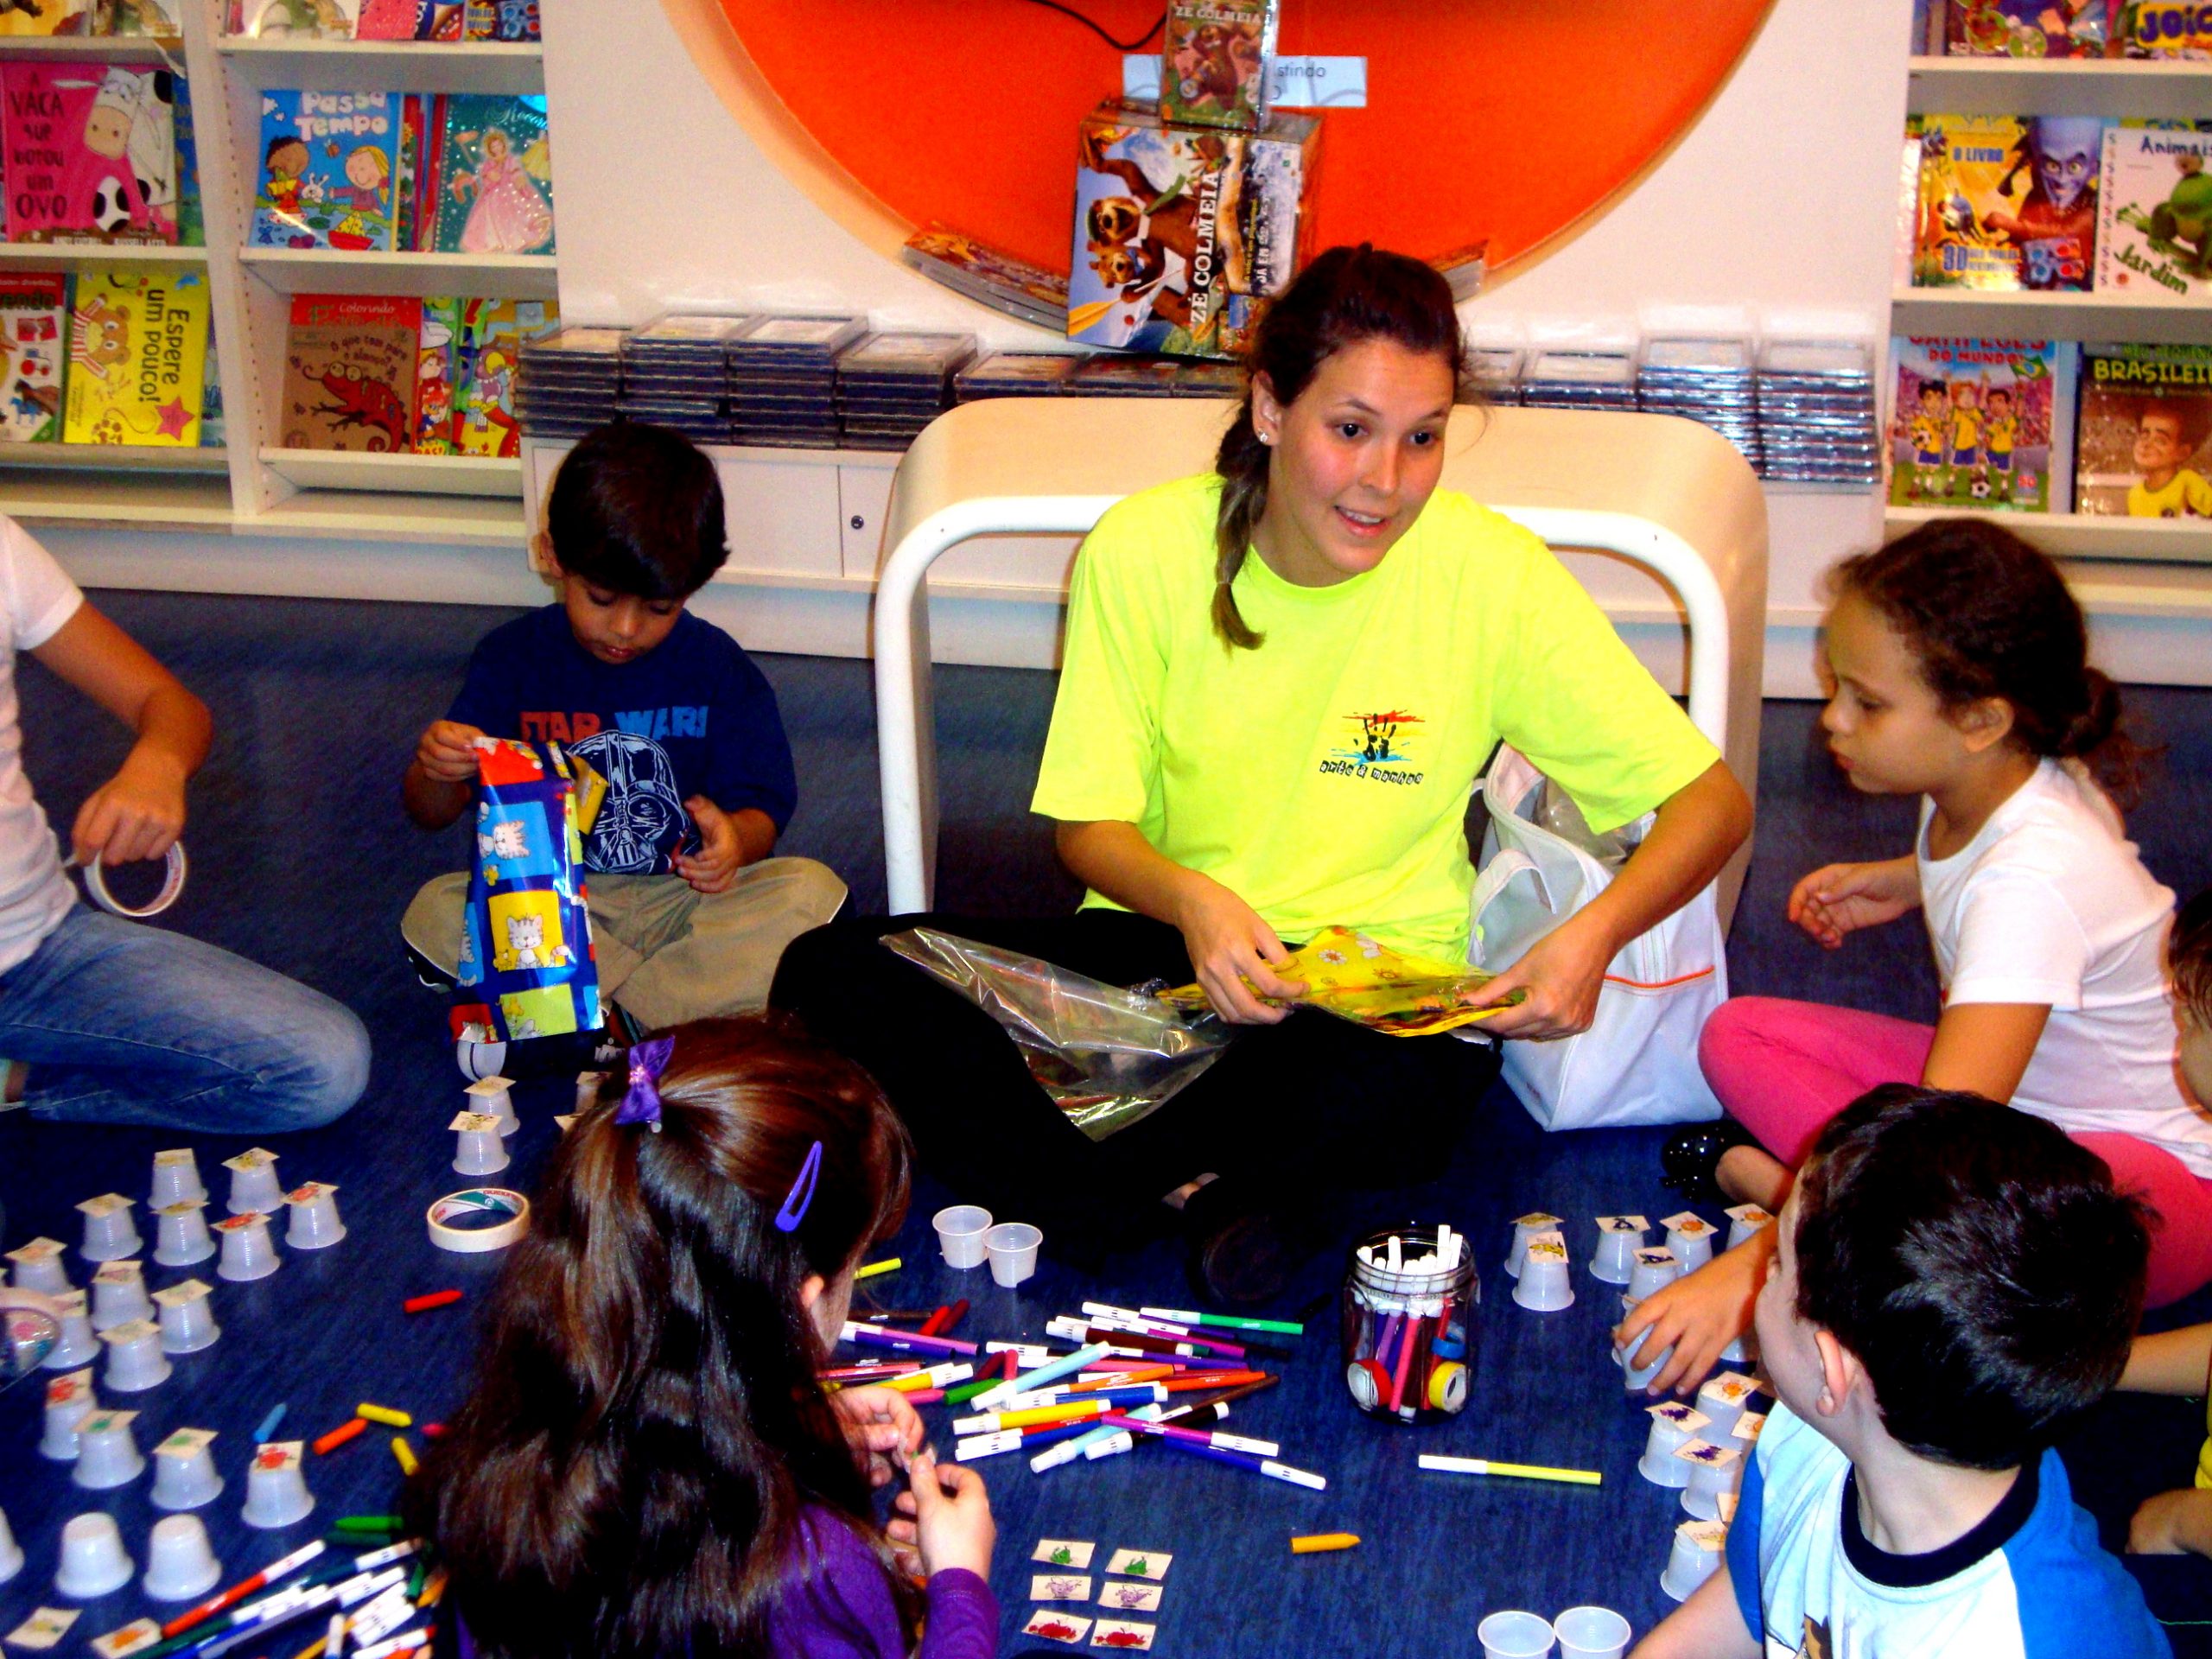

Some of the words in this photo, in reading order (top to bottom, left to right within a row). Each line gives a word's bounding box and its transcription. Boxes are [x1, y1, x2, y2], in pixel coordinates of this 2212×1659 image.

[11, 91, 65, 117] VACA
[16, 194, 68, 219] OVO
[1193, 172, 1220, 287] COLMEIA
[145, 289, 164, 322] um
[138, 330, 162, 403] pouco!
[162, 308, 190, 385] Espere
